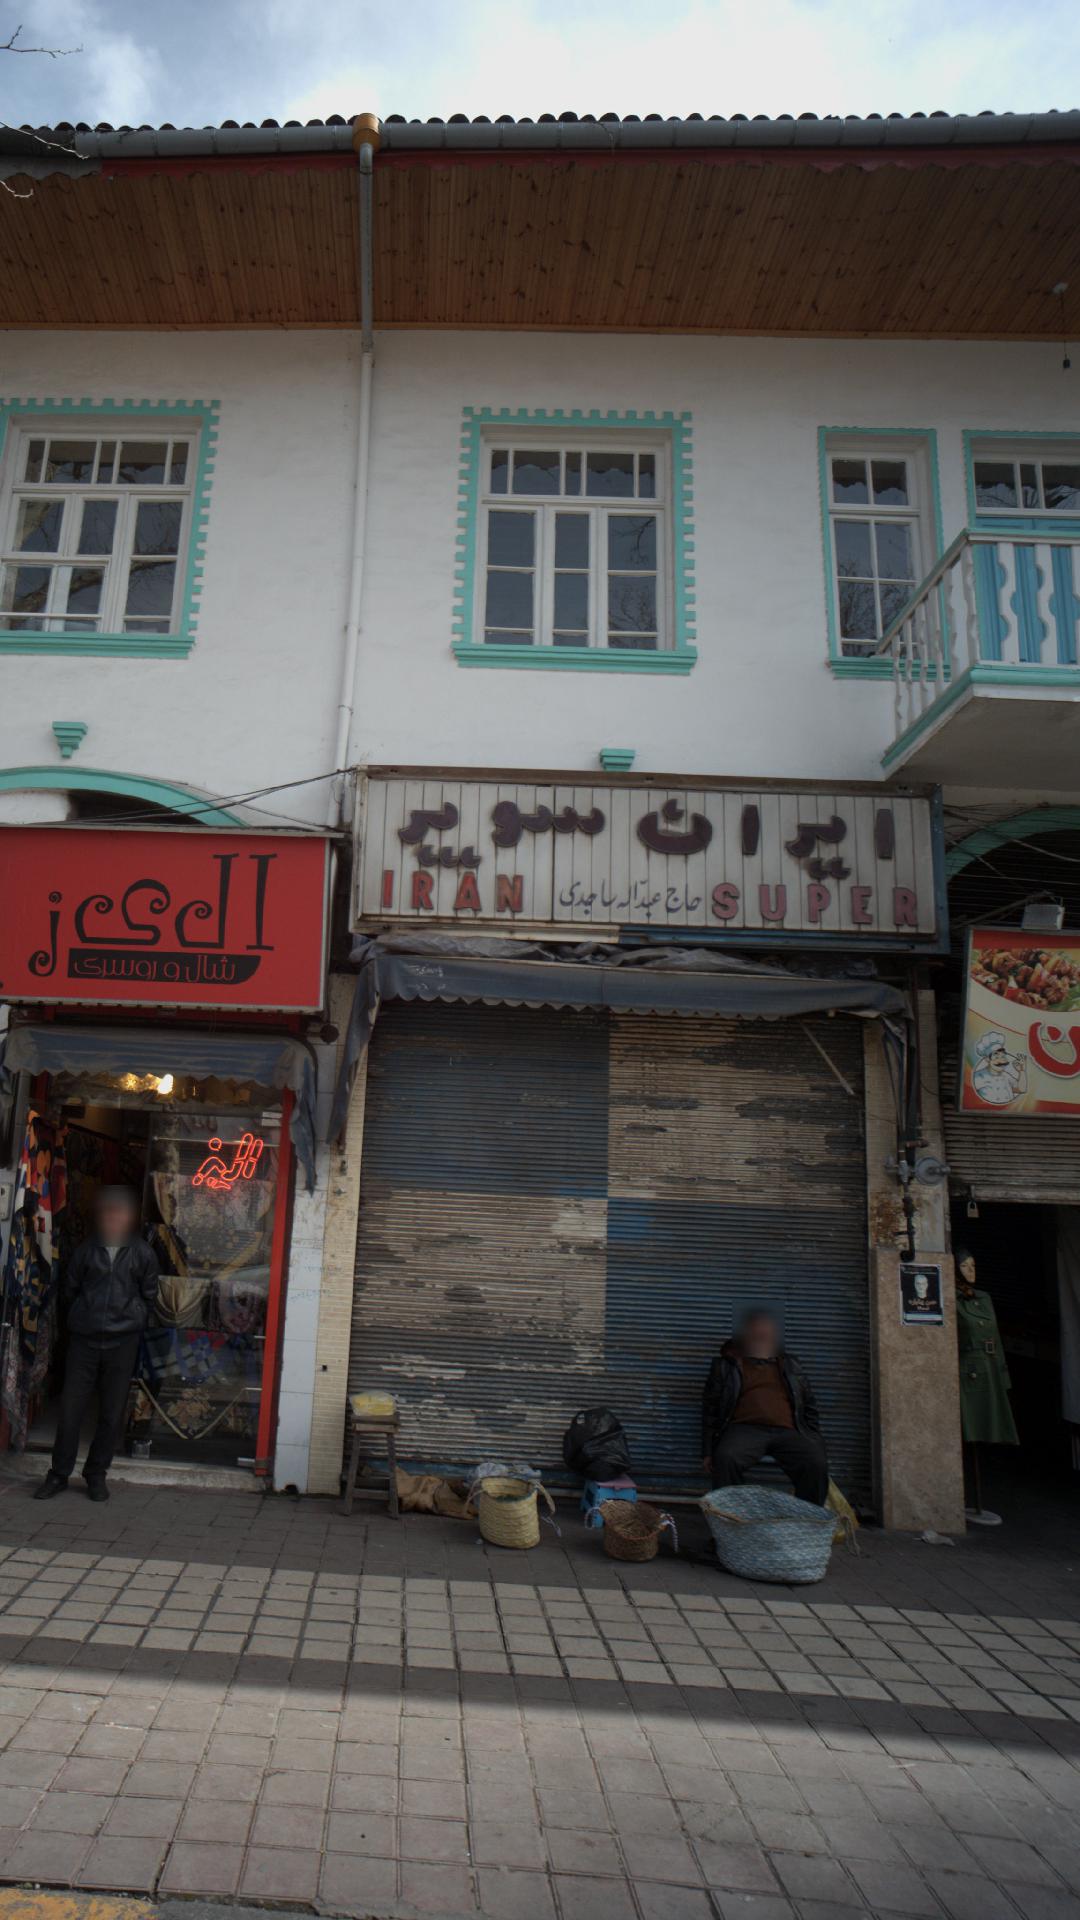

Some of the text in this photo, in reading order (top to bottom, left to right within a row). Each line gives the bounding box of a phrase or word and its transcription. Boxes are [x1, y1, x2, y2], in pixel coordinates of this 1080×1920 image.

[397, 797, 895, 879] ایران سوپر
[381, 869, 919, 926] IRAN SUPER
[559, 878, 617, 915] ساجدی
[664, 884, 703, 914] حاج
[73, 954, 236, 982] شال و روسری
